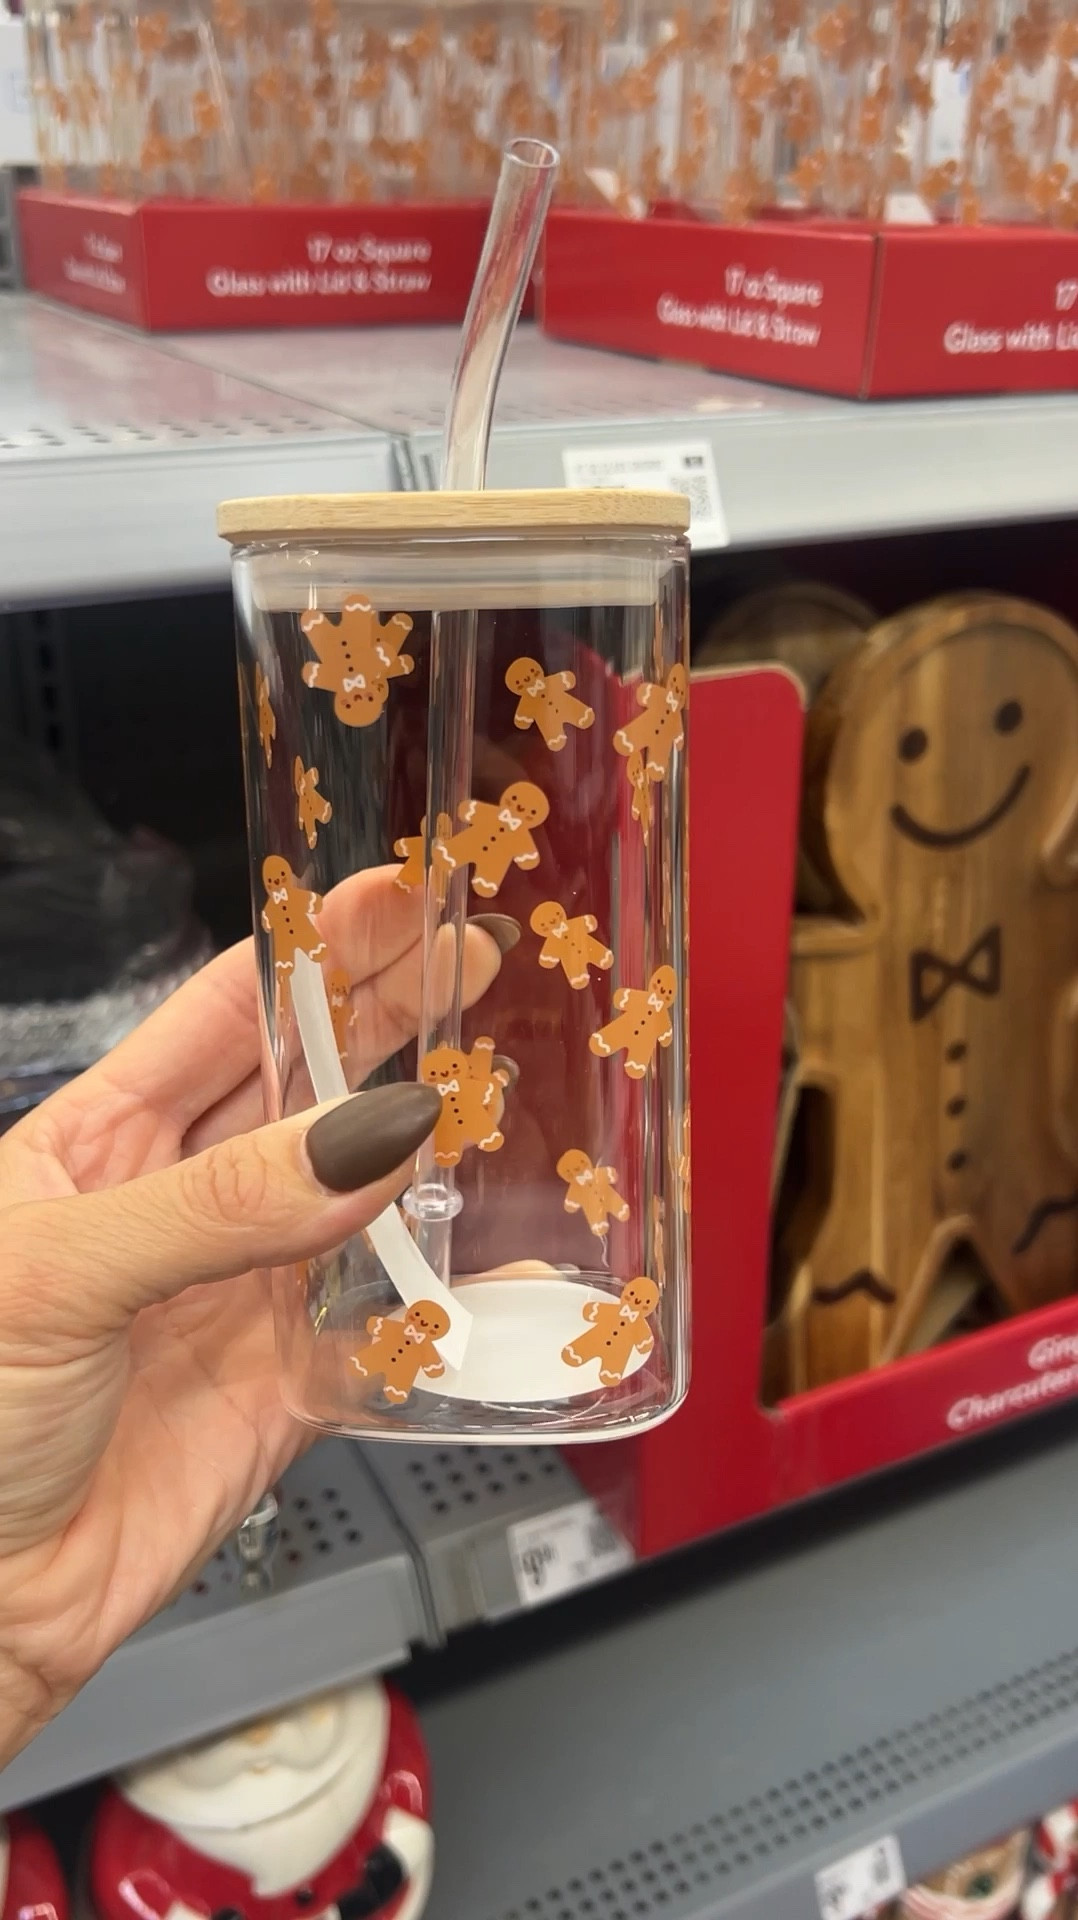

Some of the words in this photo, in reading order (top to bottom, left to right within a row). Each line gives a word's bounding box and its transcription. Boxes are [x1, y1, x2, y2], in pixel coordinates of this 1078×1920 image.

[358, 233, 432, 268] Square
[206, 267, 266, 296] Glass
[267, 266, 313, 294] with
[370, 267, 432, 294] Straw
[764, 268, 824, 310] Square
[944, 320, 1003, 353] Glass
[1005, 321, 1053, 351] with
